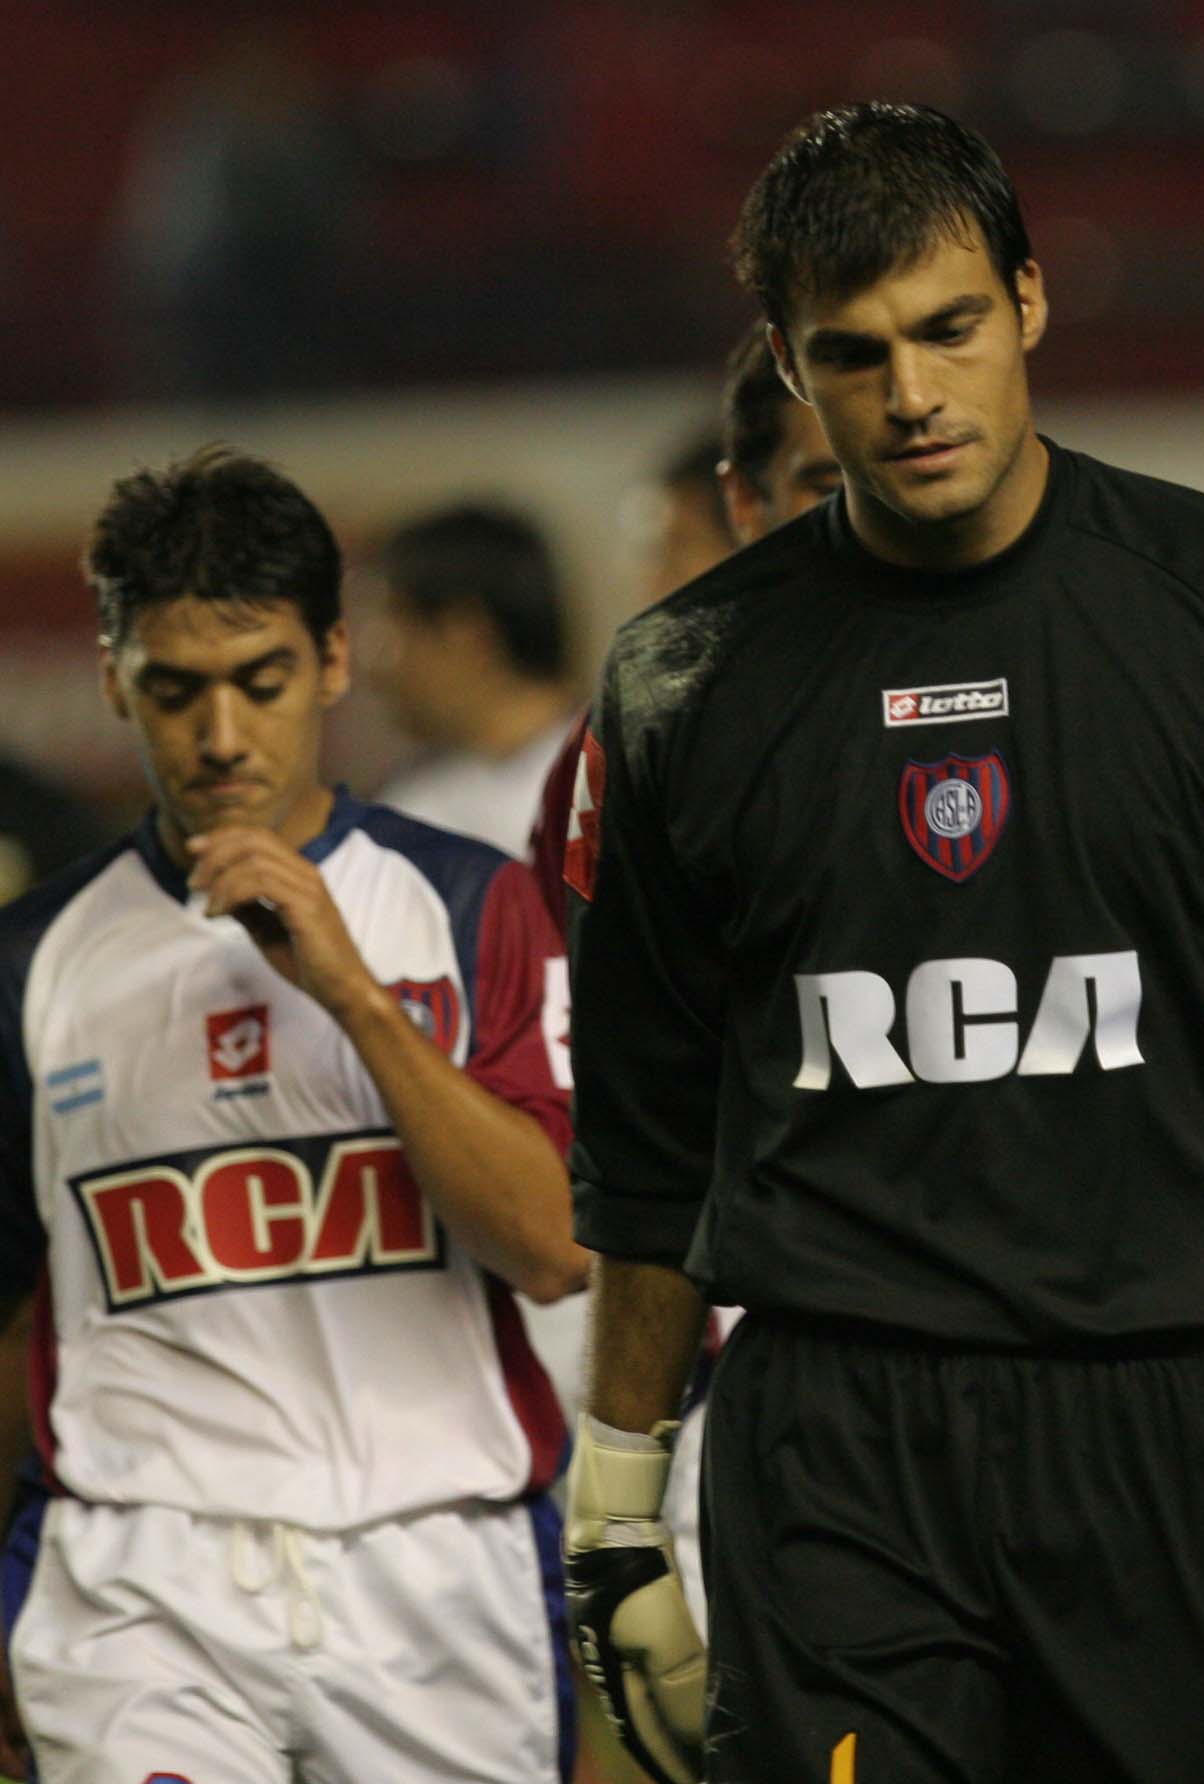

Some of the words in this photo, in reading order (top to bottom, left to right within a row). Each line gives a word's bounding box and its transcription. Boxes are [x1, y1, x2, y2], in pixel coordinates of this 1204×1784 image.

[919, 690, 1002, 715] lotto
[793, 950, 1146, 1091] RCA
[84, 1140, 435, 1300] RCA
